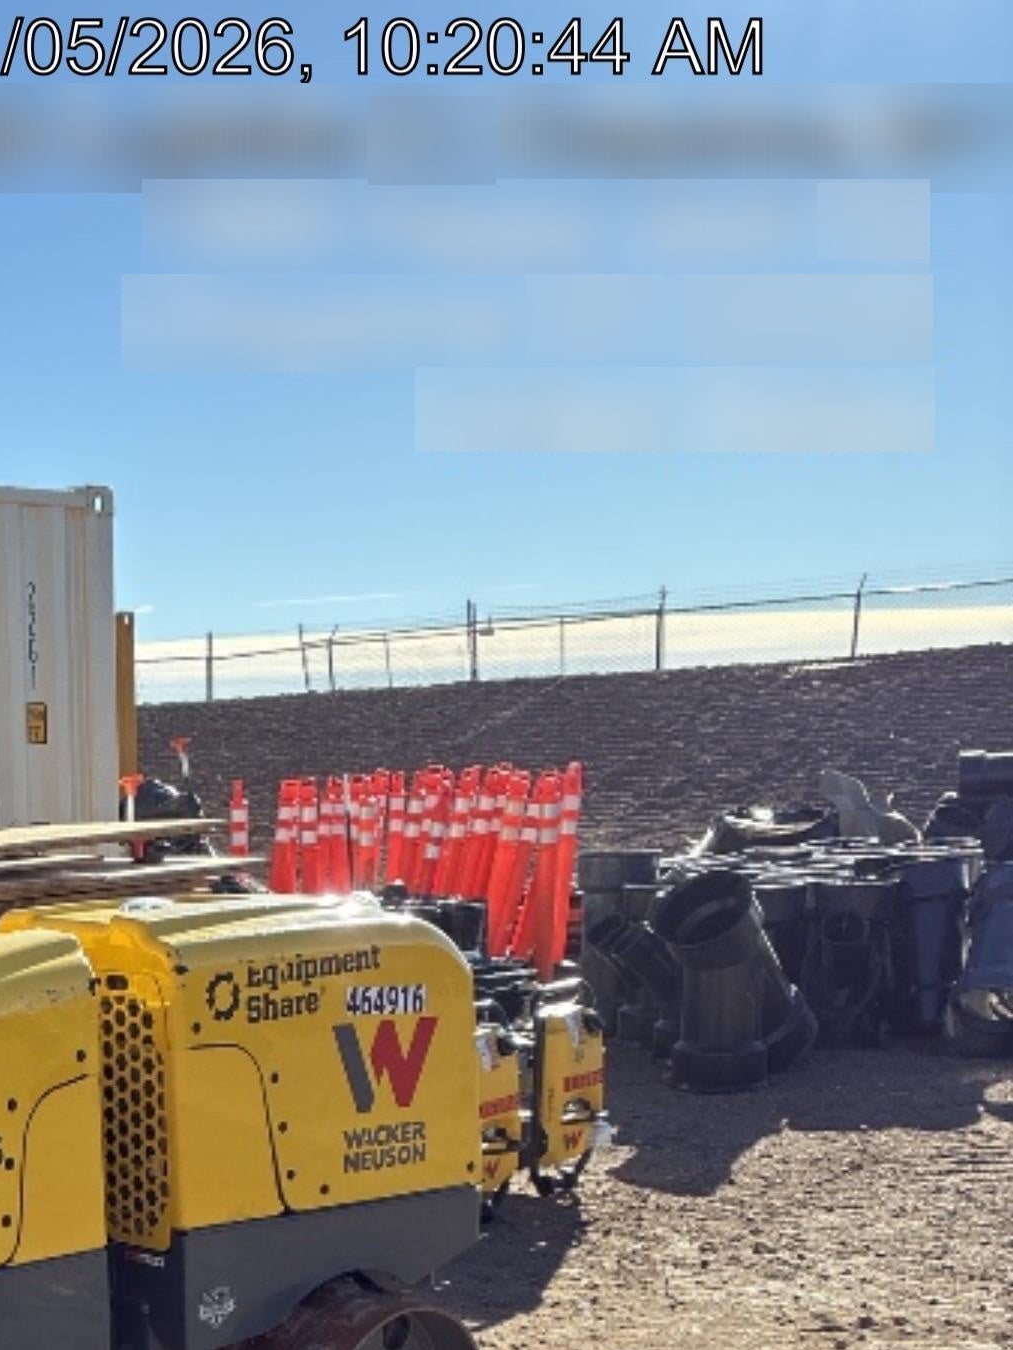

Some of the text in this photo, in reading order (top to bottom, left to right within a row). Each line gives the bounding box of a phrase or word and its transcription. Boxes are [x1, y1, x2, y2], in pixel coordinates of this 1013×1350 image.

[246, 945, 381, 990] Equipment
[247, 989, 320, 1023] Share
[345, 985, 424, 1014] 464916
[343, 1122, 426, 1149] WACKER
[343, 1143, 426, 1173] NEUSON
